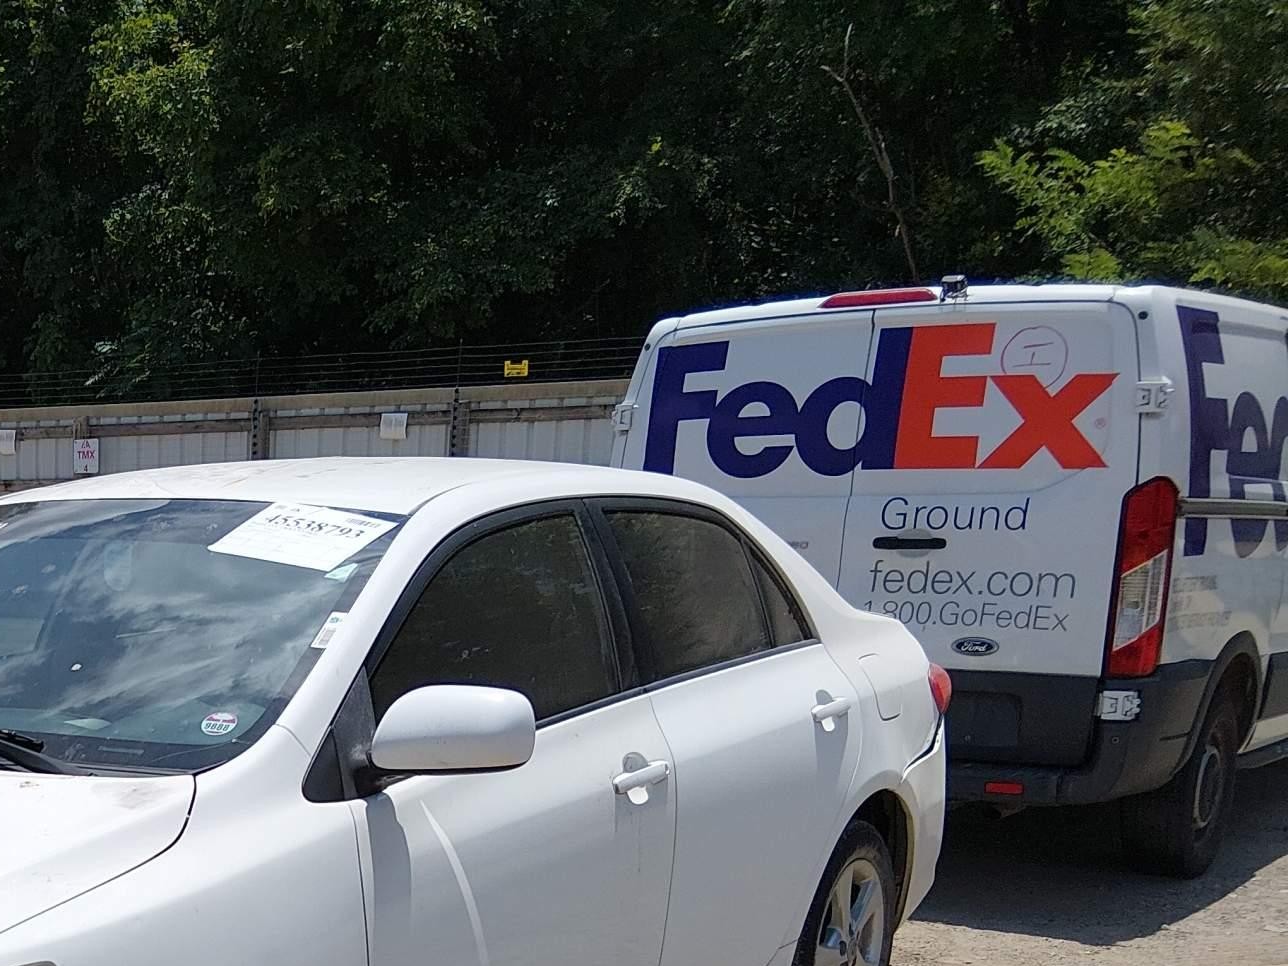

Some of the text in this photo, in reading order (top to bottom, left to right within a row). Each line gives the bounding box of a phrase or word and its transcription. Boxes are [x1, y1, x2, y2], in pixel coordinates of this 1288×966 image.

[643, 323, 1120, 478] FedEx
[77, 450, 96, 460] TMX
[265, 514, 365, 538] 45538793
[881, 496, 1031, 531] Ground
[869, 560, 1076, 599] fedex.com
[863, 600, 1070, 632] 1800.GoFedEx
